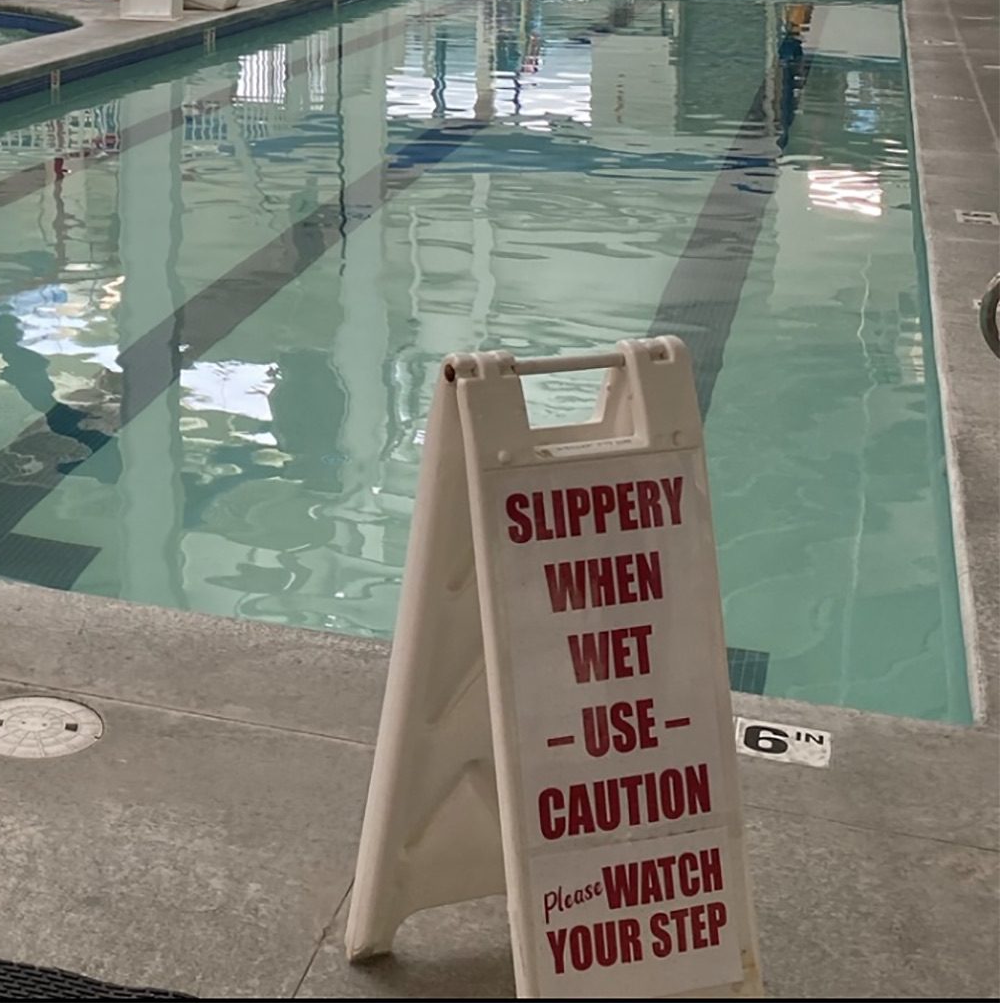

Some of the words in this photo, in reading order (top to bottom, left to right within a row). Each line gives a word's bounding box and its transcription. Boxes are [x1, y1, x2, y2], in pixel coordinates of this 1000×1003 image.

[505, 476, 683, 543] SLIPPERY
[544, 551, 663, 613] WHEN
[567, 624, 652, 684] WET
[743, 725, 789, 754] 6
[795, 731, 824, 745] IN
[538, 763, 711, 840] CAUTION
[543, 881, 604, 924] Please
[602, 848, 723, 910] WATCH
[546, 918, 643, 974] YOUR
[649, 901, 727, 958] STEP
